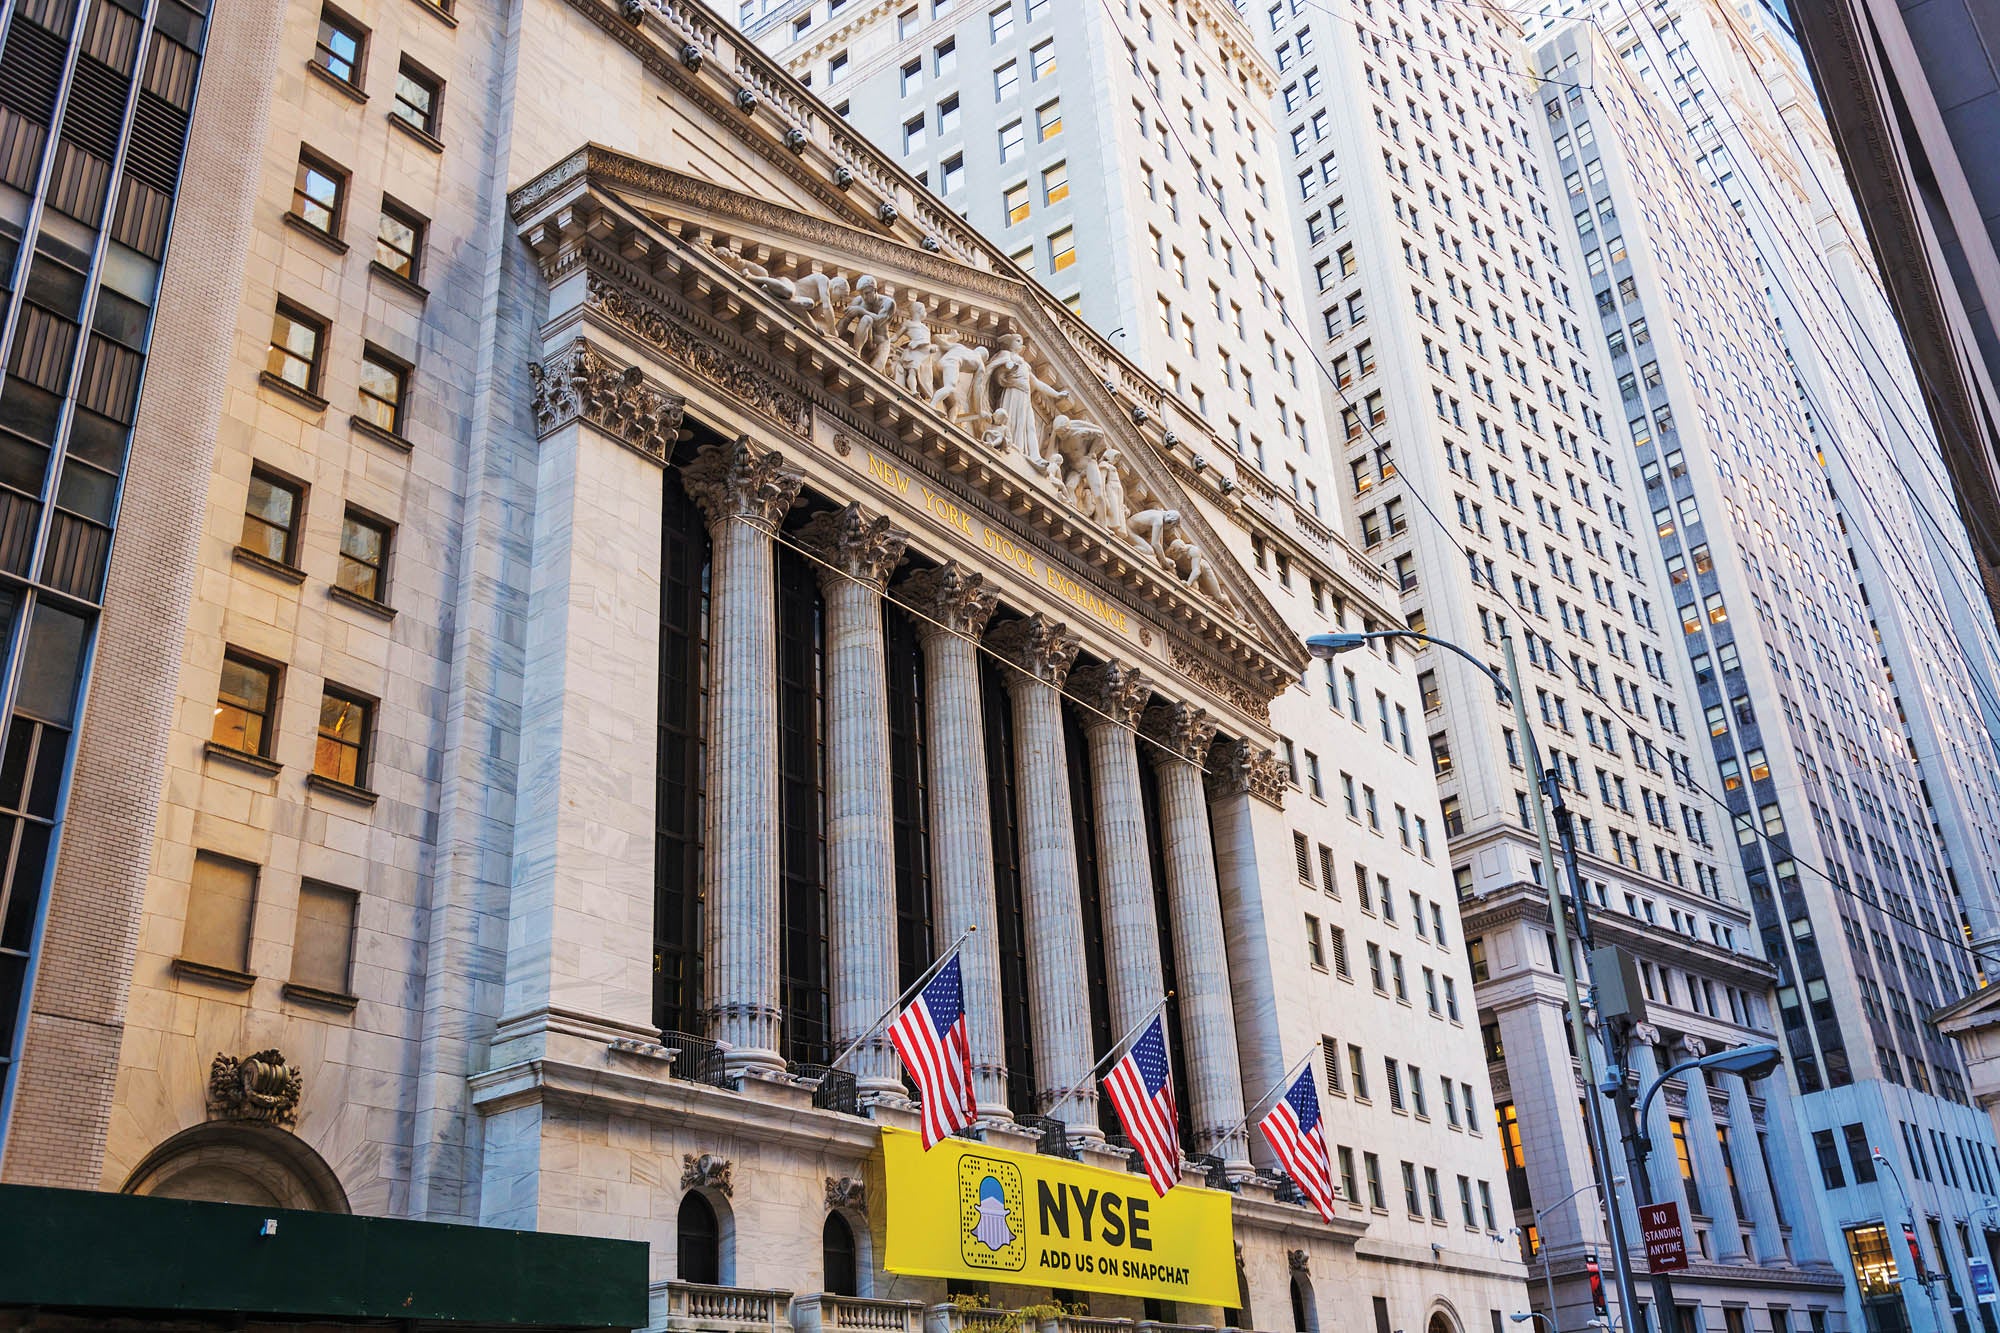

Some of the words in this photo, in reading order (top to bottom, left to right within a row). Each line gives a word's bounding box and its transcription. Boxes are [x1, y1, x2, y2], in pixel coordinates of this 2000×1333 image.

[868, 453, 910, 494] NEW
[922, 487, 974, 536] YORK
[983, 528, 1038, 577] STOCK
[1046, 567, 1129, 633] EXCHANGE
[1037, 1180, 1153, 1251] NYSE
[1652, 1210, 1667, 1225] NO
[1645, 1226, 1681, 1242] STANDING
[1650, 1242, 1682, 1256] ANYTIME
[1040, 1249, 1071, 1270] ADD
[1075, 1254, 1094, 1273] US
[1098, 1257, 1119, 1276] ON
[1122, 1259, 1189, 1285] SNAPCHAT
